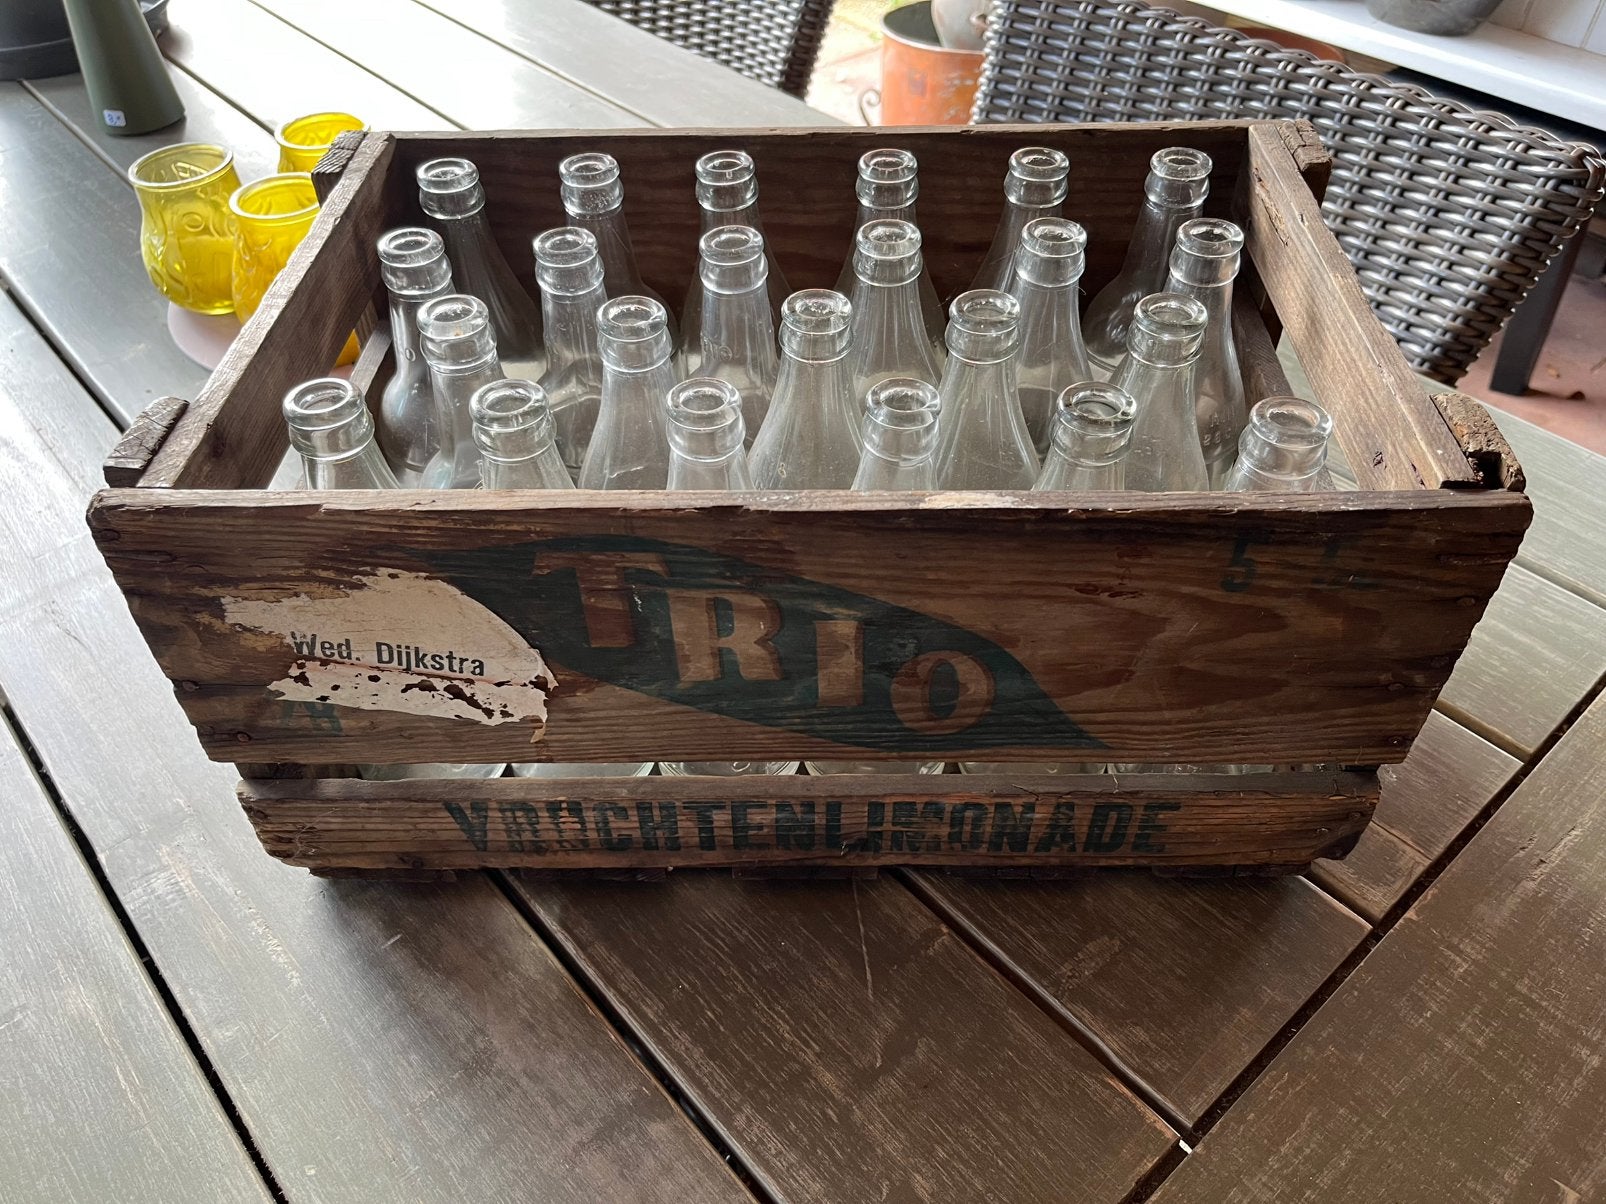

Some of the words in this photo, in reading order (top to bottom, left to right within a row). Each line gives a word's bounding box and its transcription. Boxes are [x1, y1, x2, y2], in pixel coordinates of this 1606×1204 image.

[290, 630, 362, 662] Wed.
[375, 641, 485, 677] Dijkstra
[531, 551, 995, 735] TRIO
[443, 799, 1181, 853] VRUCHTENLIMONADE
